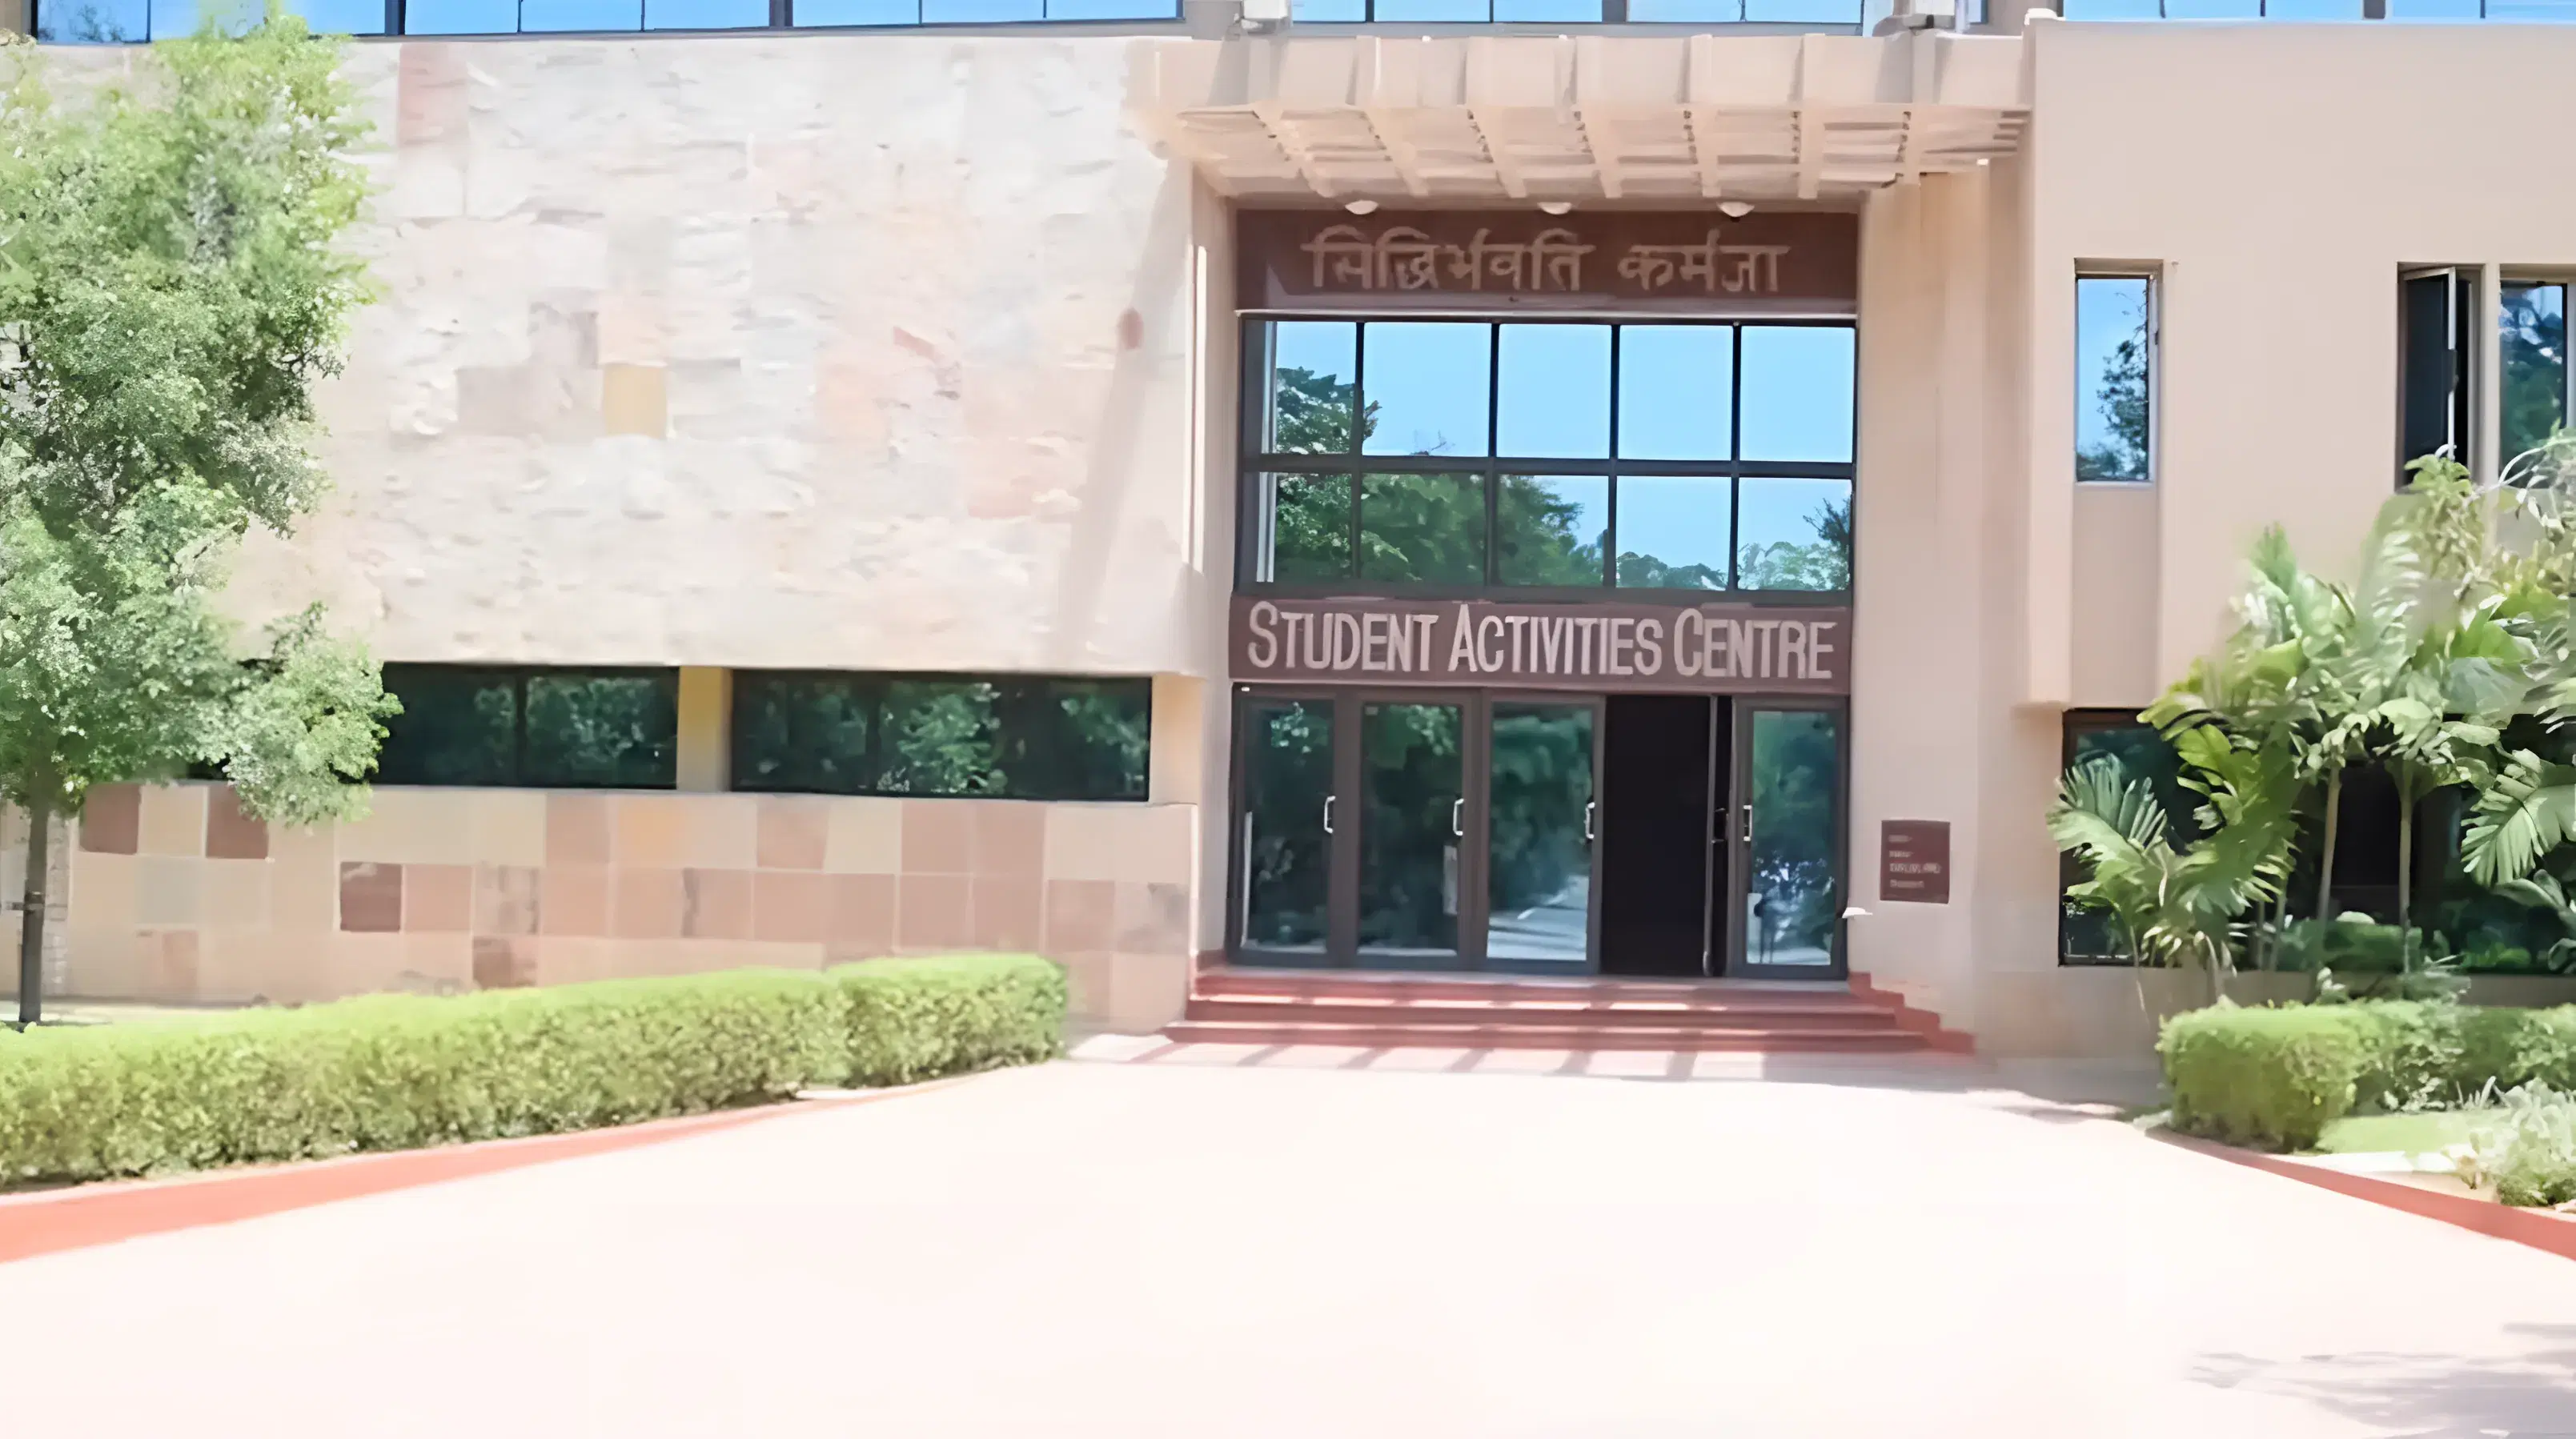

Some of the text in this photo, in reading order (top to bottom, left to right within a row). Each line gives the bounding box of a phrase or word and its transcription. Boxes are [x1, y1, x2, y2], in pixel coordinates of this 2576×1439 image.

[1617, 227, 1792, 292] कर्मजा
[1248, 601, 1838, 679] STUDENT ACTIVITIES CENTRE
